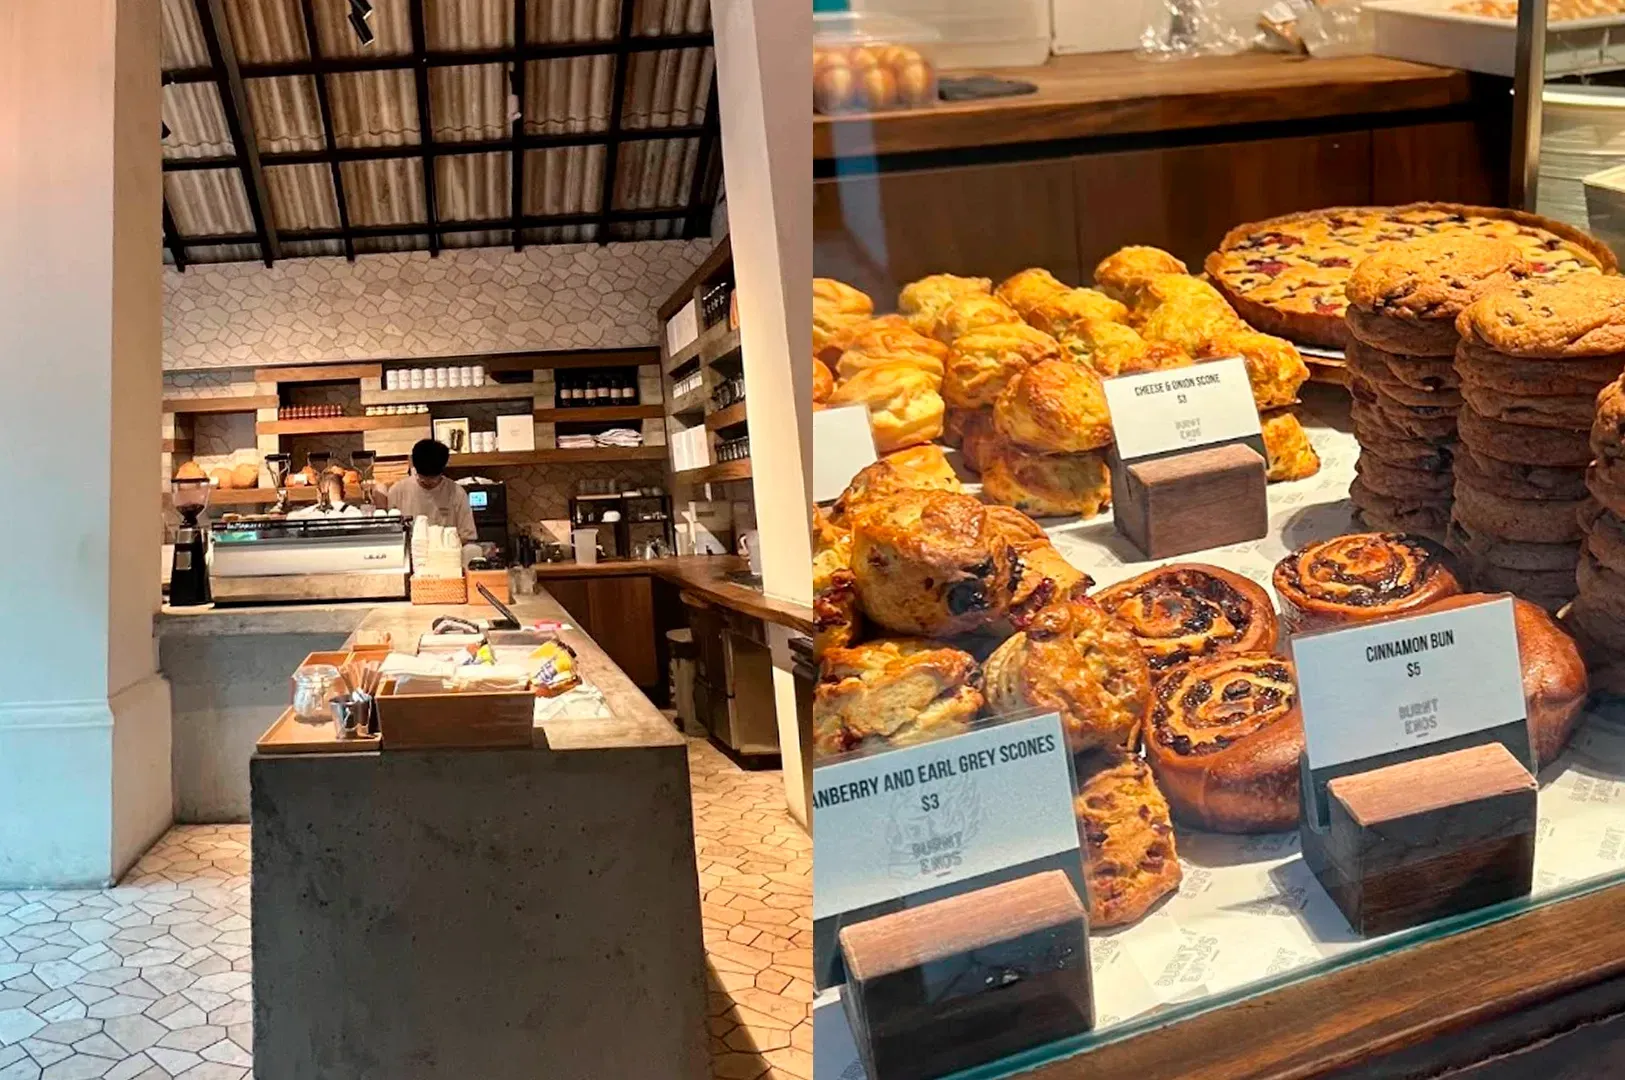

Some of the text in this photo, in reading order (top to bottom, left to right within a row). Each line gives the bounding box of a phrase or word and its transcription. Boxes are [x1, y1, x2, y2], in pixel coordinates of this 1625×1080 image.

[1134, 373, 1220, 396] CHEESE & ONION SCONE
[1366, 629, 1455, 662] CINNAMON BUN
[1406, 661, 1421, 677] $5
[1399, 699, 1439, 720] BURNT
[884, 768, 915, 792] AND
[917, 758, 957, 784] EARL
[958, 748, 996, 773] GREY
[998, 734, 1056, 763] SCONES
[920, 793, 940, 812] $3
